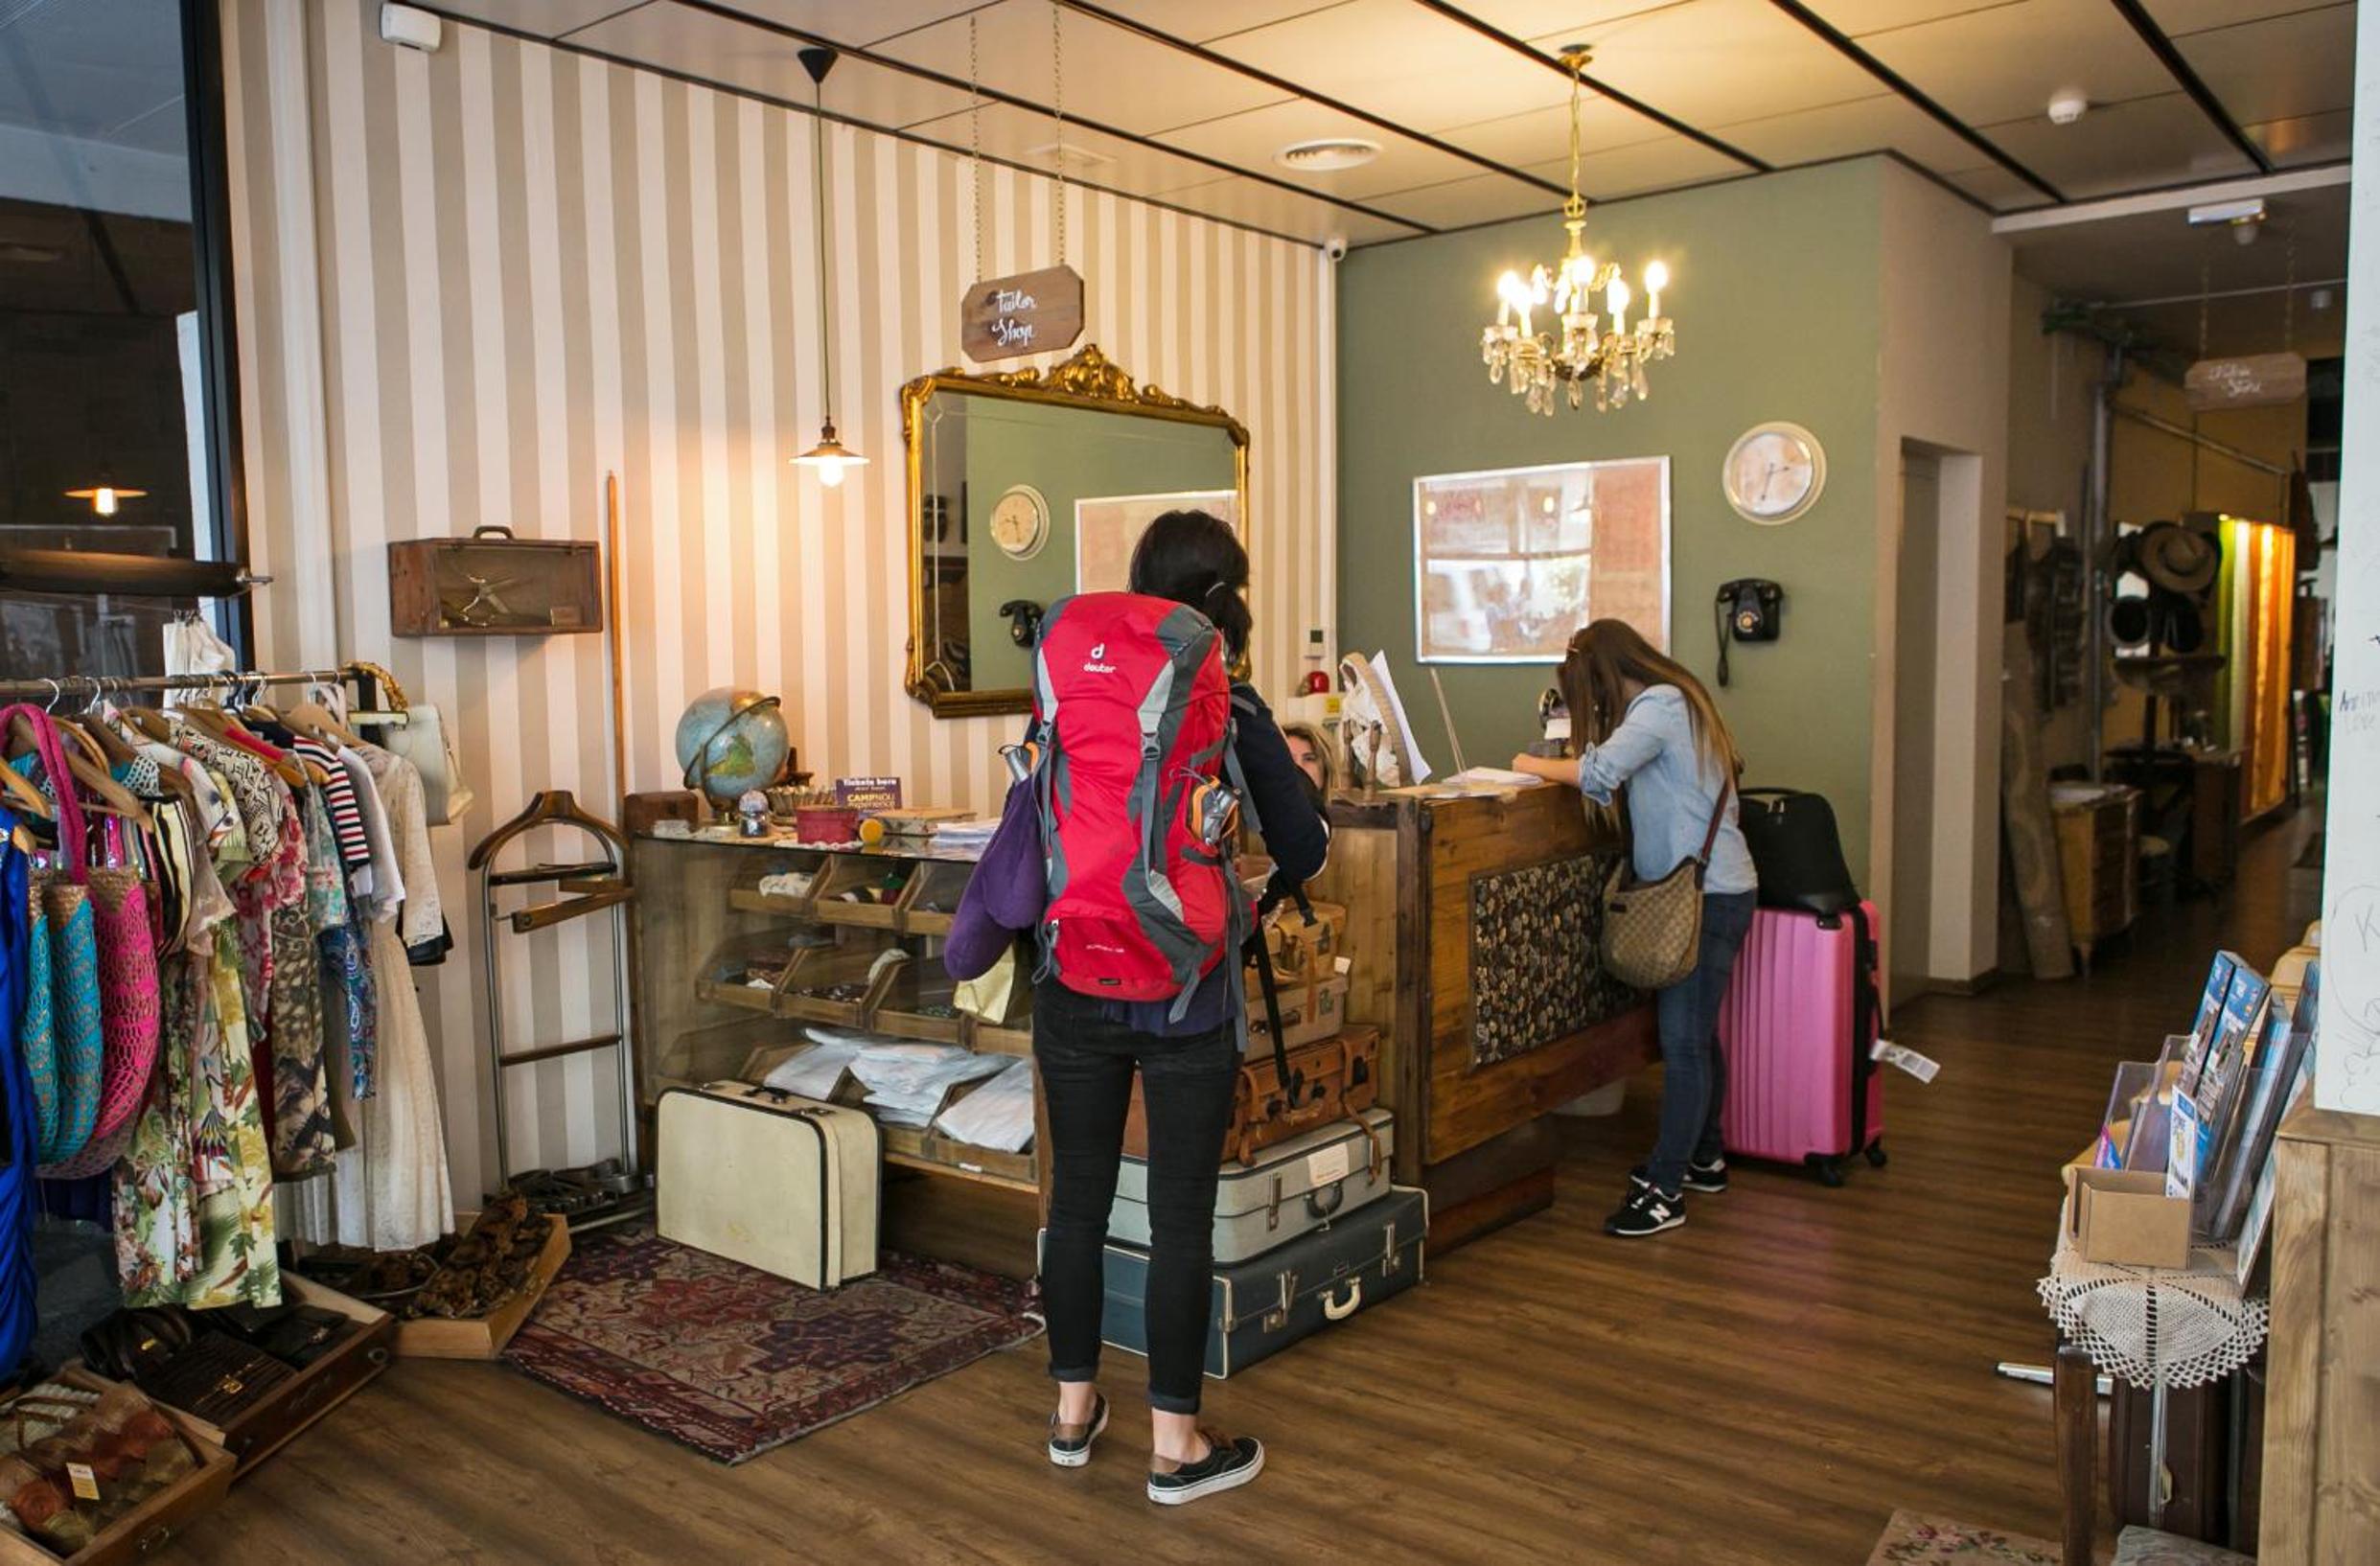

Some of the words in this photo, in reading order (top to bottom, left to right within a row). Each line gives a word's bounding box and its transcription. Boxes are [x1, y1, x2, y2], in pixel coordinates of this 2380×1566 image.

[997, 289, 1036, 312] Tailor
[991, 318, 1035, 346] Shop
[1083, 661, 1117, 673] deuter
